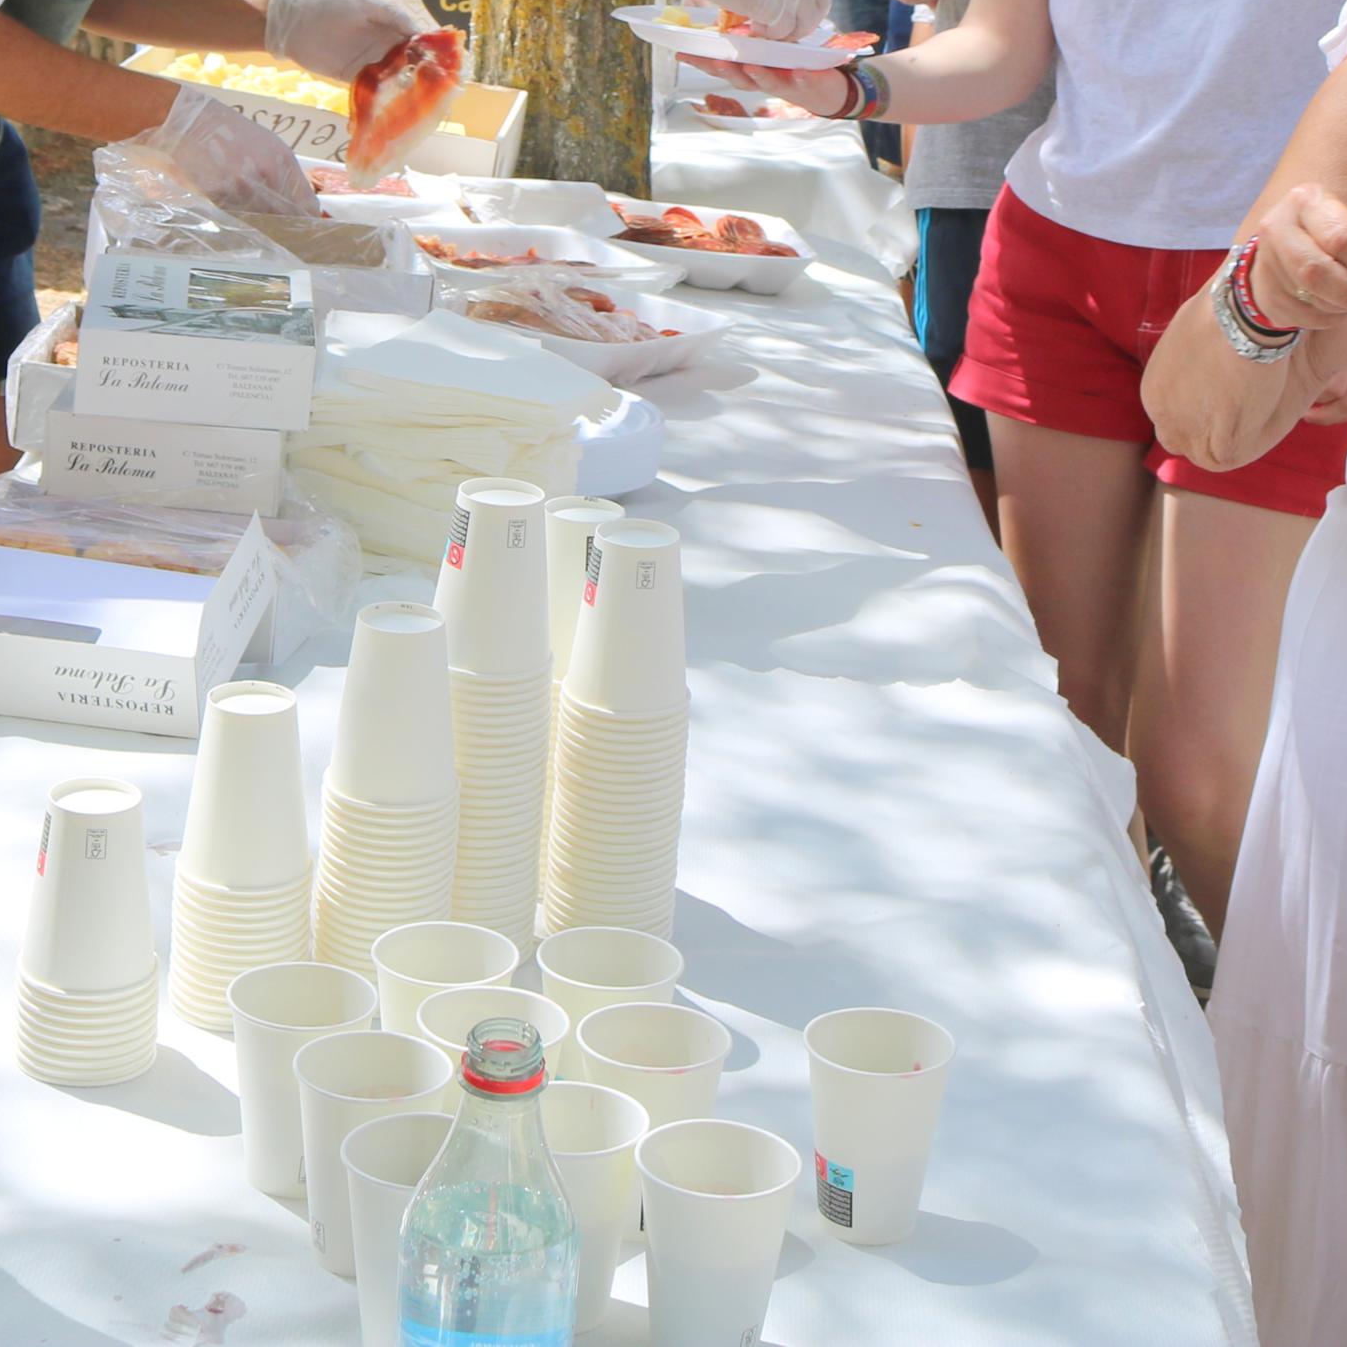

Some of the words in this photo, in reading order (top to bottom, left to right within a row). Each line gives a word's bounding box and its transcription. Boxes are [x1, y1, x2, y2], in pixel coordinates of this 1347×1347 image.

[102, 356, 190, 372] REPOSTERIA
[99, 369, 122, 388] La
[127, 371, 189, 392] Paloma
[70, 441, 156, 458] REPOSTERIA
[66, 452, 90, 471] La
[95, 458, 156, 479] Paloma
[53, 665, 135, 695] Paloma
[144, 677, 177, 702] La
[57, 691, 174, 715] REPOSTERIA
